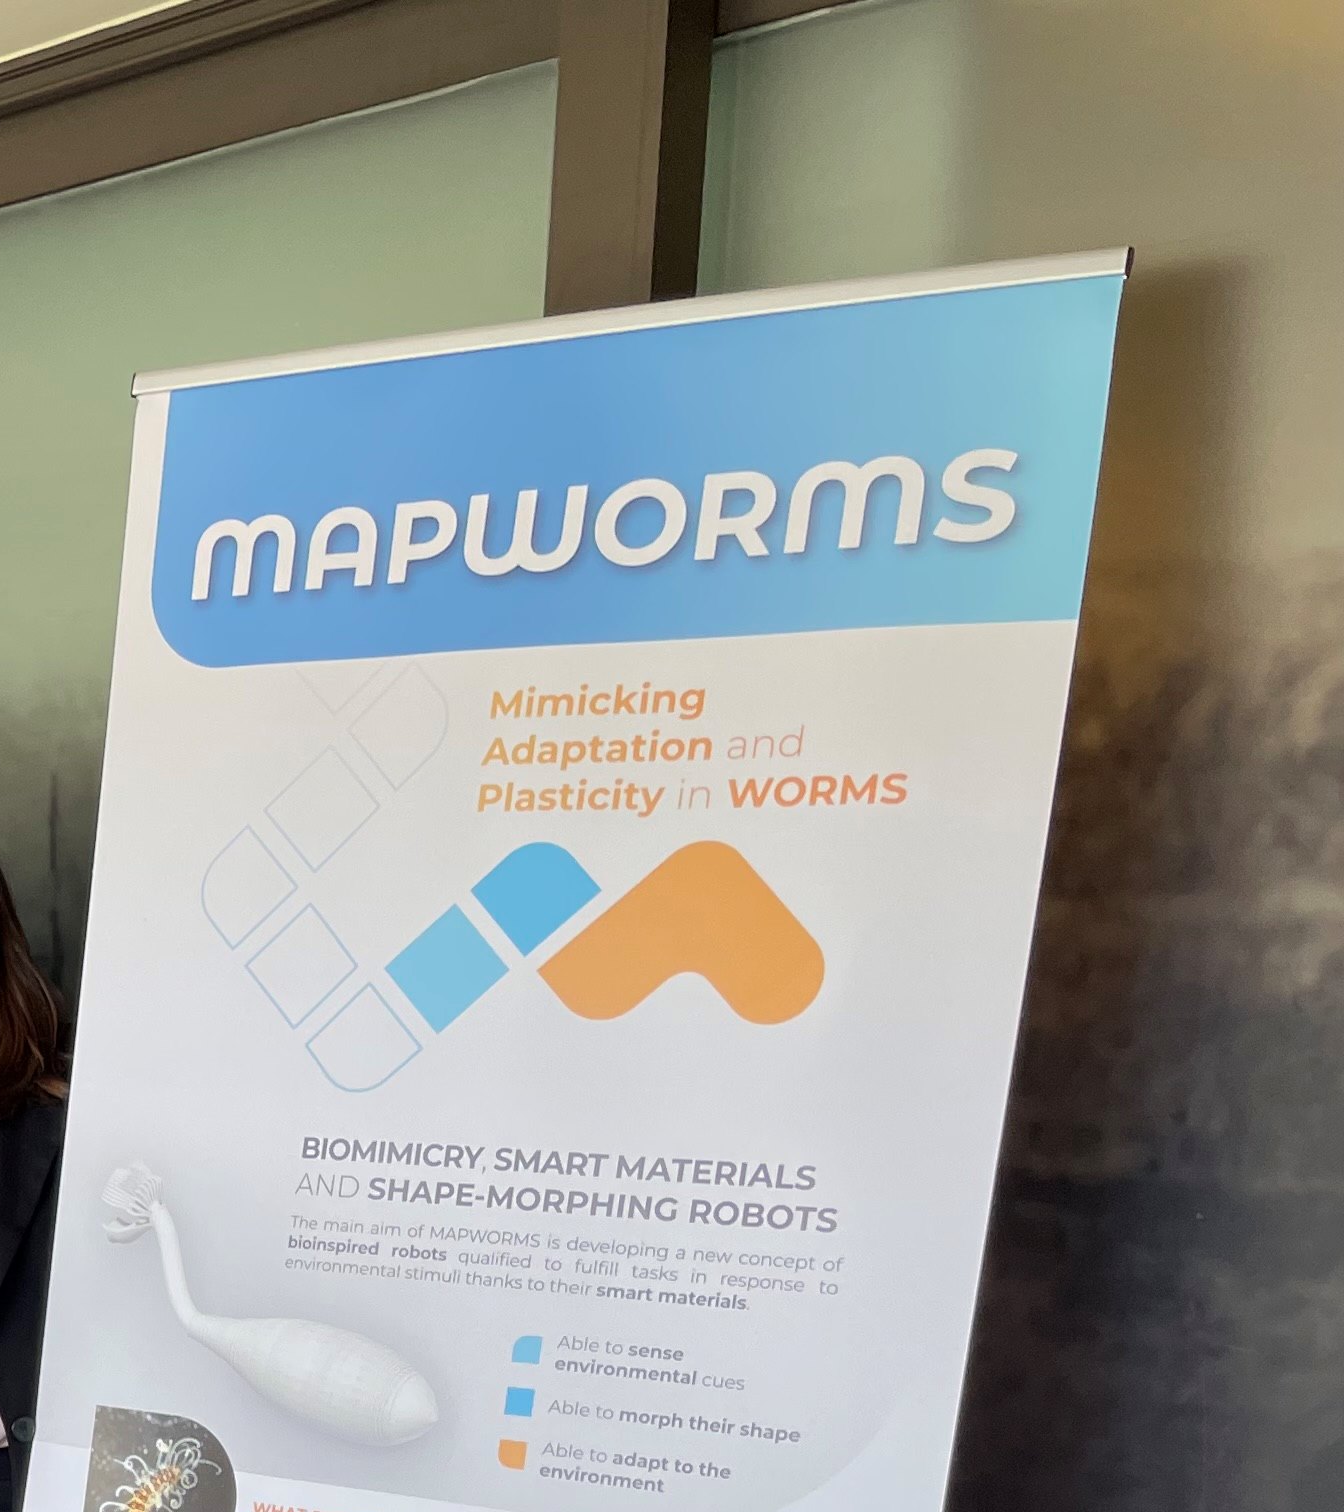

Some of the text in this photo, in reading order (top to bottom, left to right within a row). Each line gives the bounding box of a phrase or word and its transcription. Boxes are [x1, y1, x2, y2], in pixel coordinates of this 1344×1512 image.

[192, 448, 1018, 601] MAPWORMS
[490, 681, 705, 720] Mimicking
[480, 724, 804, 769] Adaptation and
[477, 772, 908, 816] Plasticity in WORMS
[301, 1136, 816, 1190] BIOMIMICRY, SMART MATERIALS
[294, 1172, 837, 1232] AND SHAPE-MORPHING ROBOTS
[287, 1234, 838, 1295] bioinspired robots qualified to fulfill tasks in response to
[290, 1214, 844, 1273] The main aim of MAPWORMS is developing a new concept of
[284, 1257, 749, 1310] environmental stimuli thanks to their smart materials.
[556, 1335, 684, 1361] Able to sense
[554, 1358, 744, 1390] environmental cues
[547, 1399, 800, 1444] Able to morph their shape
[539, 1466, 664, 1492] environment
[541, 1442, 731, 1479] Able to adapt to the
